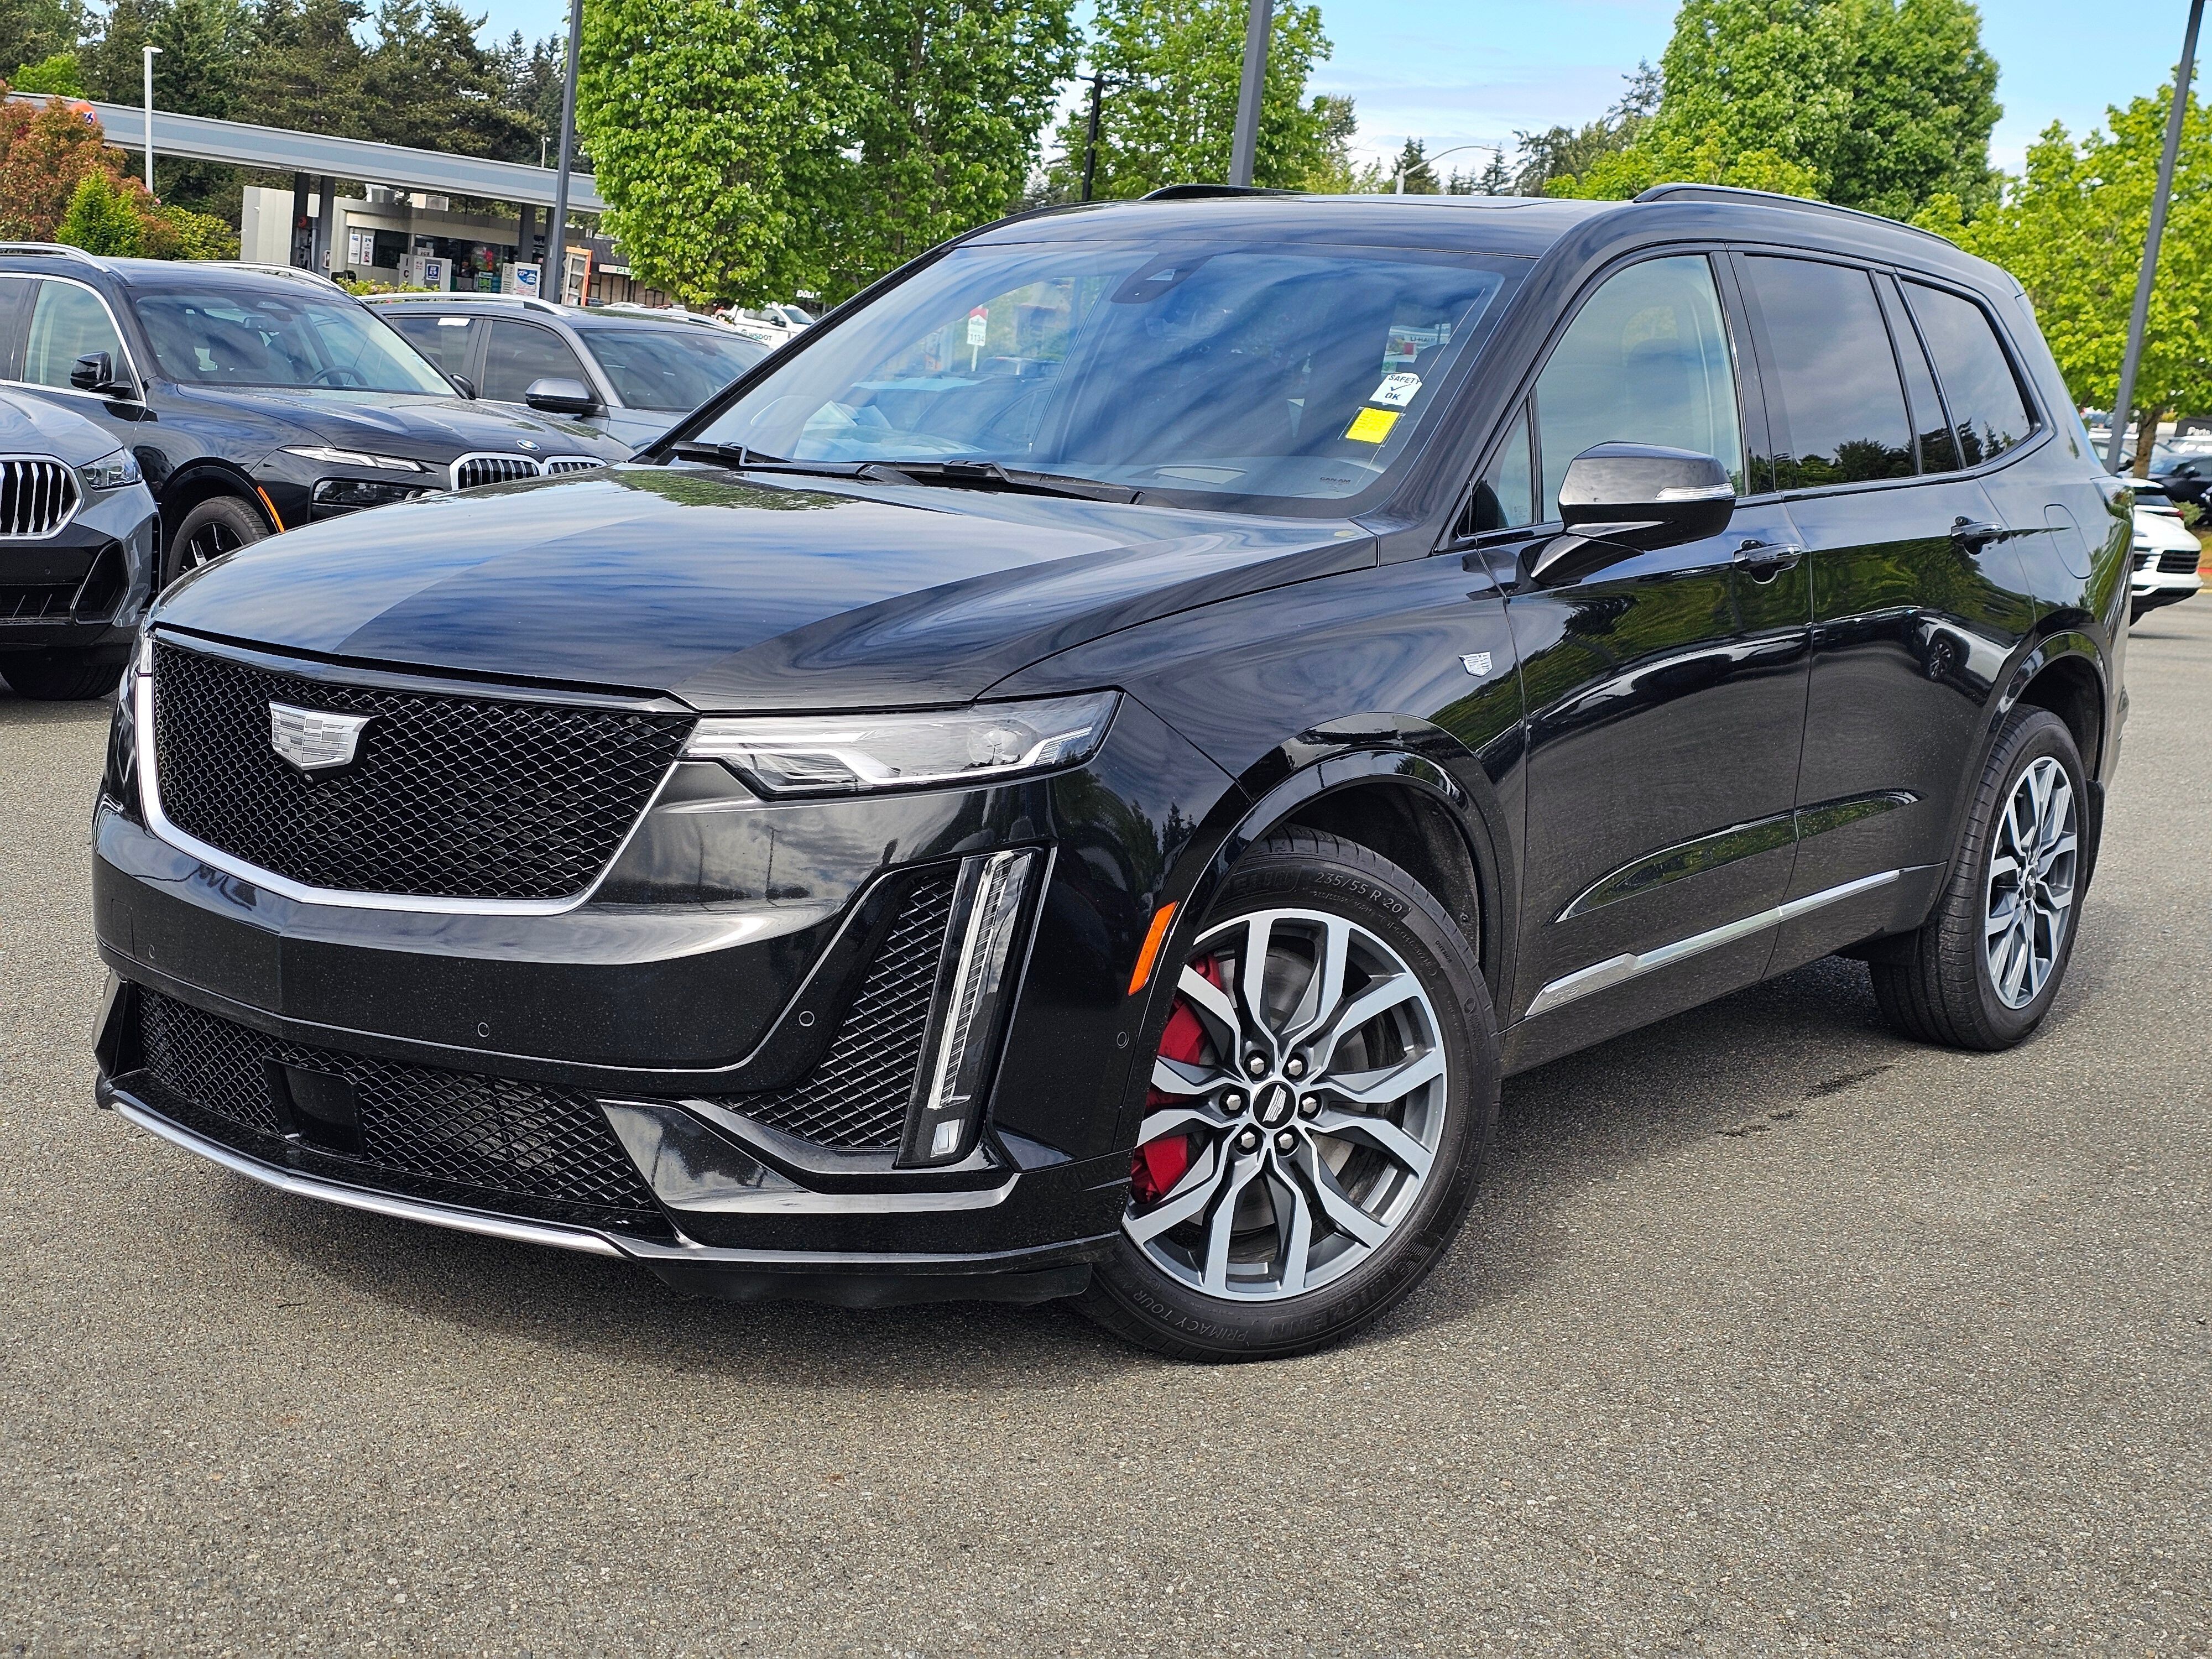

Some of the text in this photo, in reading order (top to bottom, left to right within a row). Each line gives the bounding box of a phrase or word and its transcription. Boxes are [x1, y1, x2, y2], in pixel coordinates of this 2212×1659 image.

[748, 332, 772, 341] WSDOT
[1388, 374, 1421, 385] SAFETY
[1384, 392, 1401, 400] OK
[1314, 871, 1403, 914] 235/55 R 20
[1134, 1290, 1173, 1321] TOUR
[1175, 1316, 1249, 1342] PRIMACY
